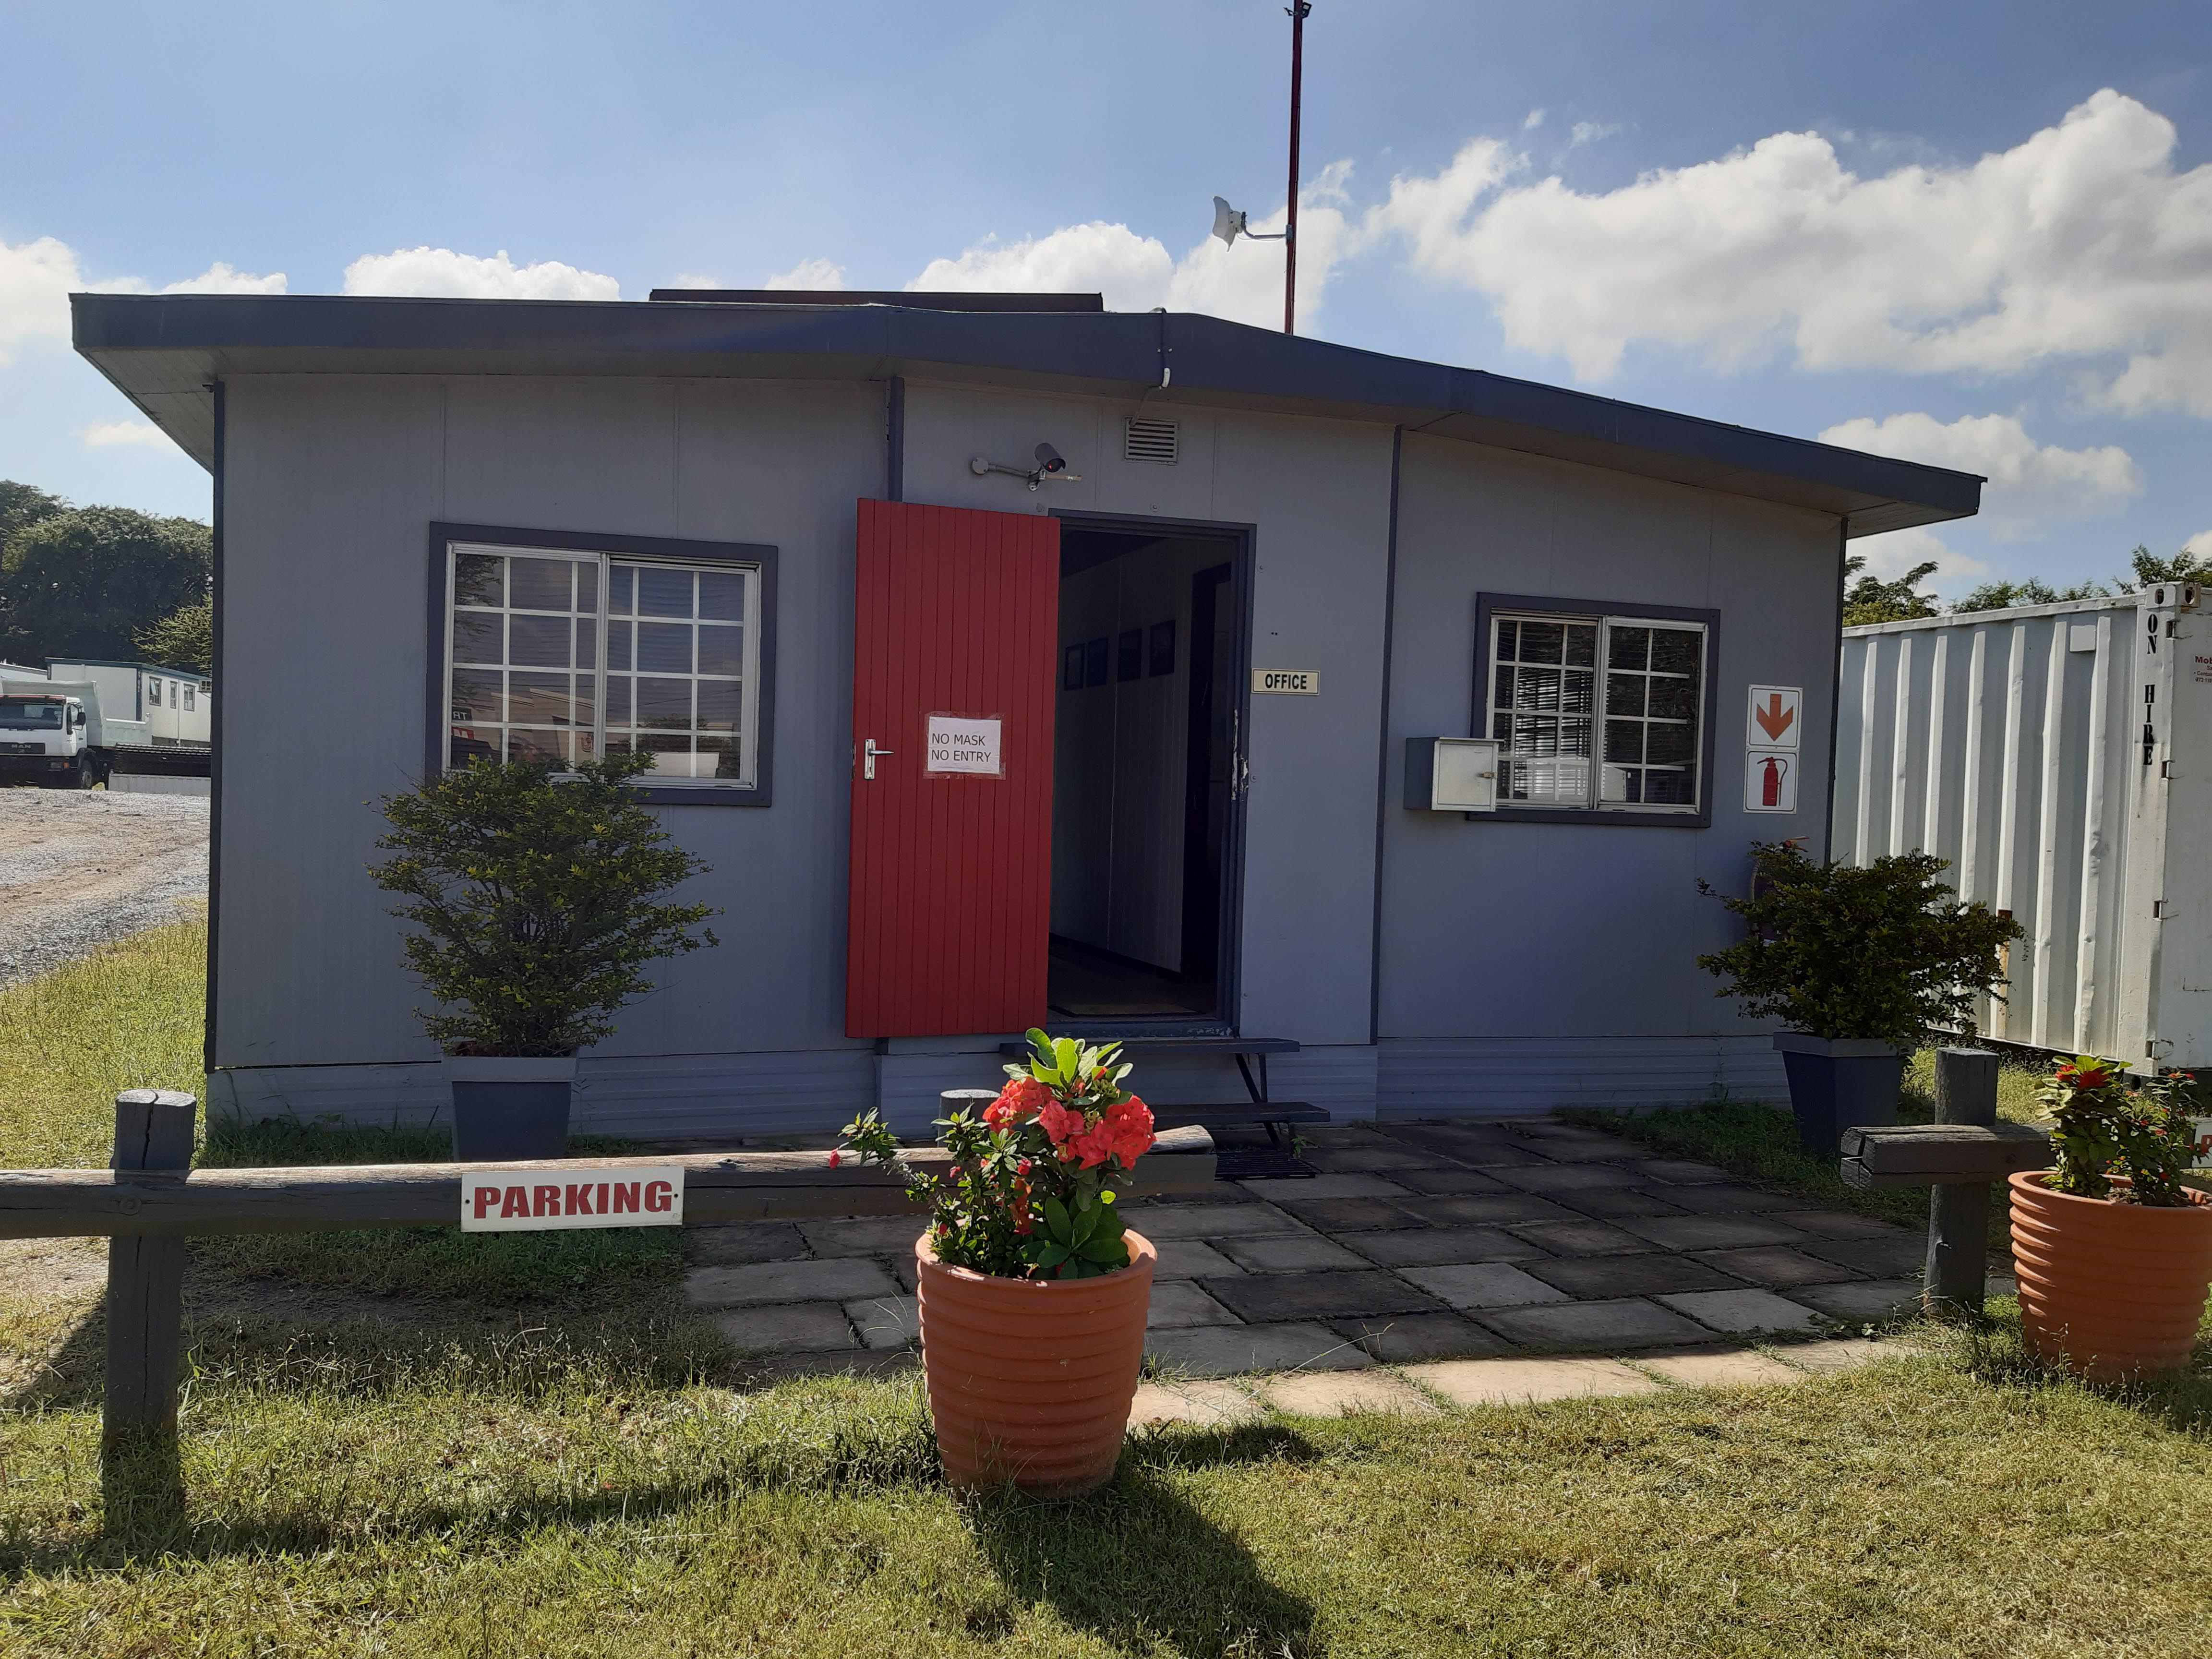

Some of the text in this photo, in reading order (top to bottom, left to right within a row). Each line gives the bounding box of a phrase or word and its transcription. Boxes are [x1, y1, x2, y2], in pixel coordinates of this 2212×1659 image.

[1265, 673, 1307, 690] OFFICE
[2143, 614, 2158, 766] ON HIRE
[932, 733, 986, 746] NO MASK
[931, 749, 991, 762] NO ENTRY
[474, 1180, 673, 1219] PARKING
